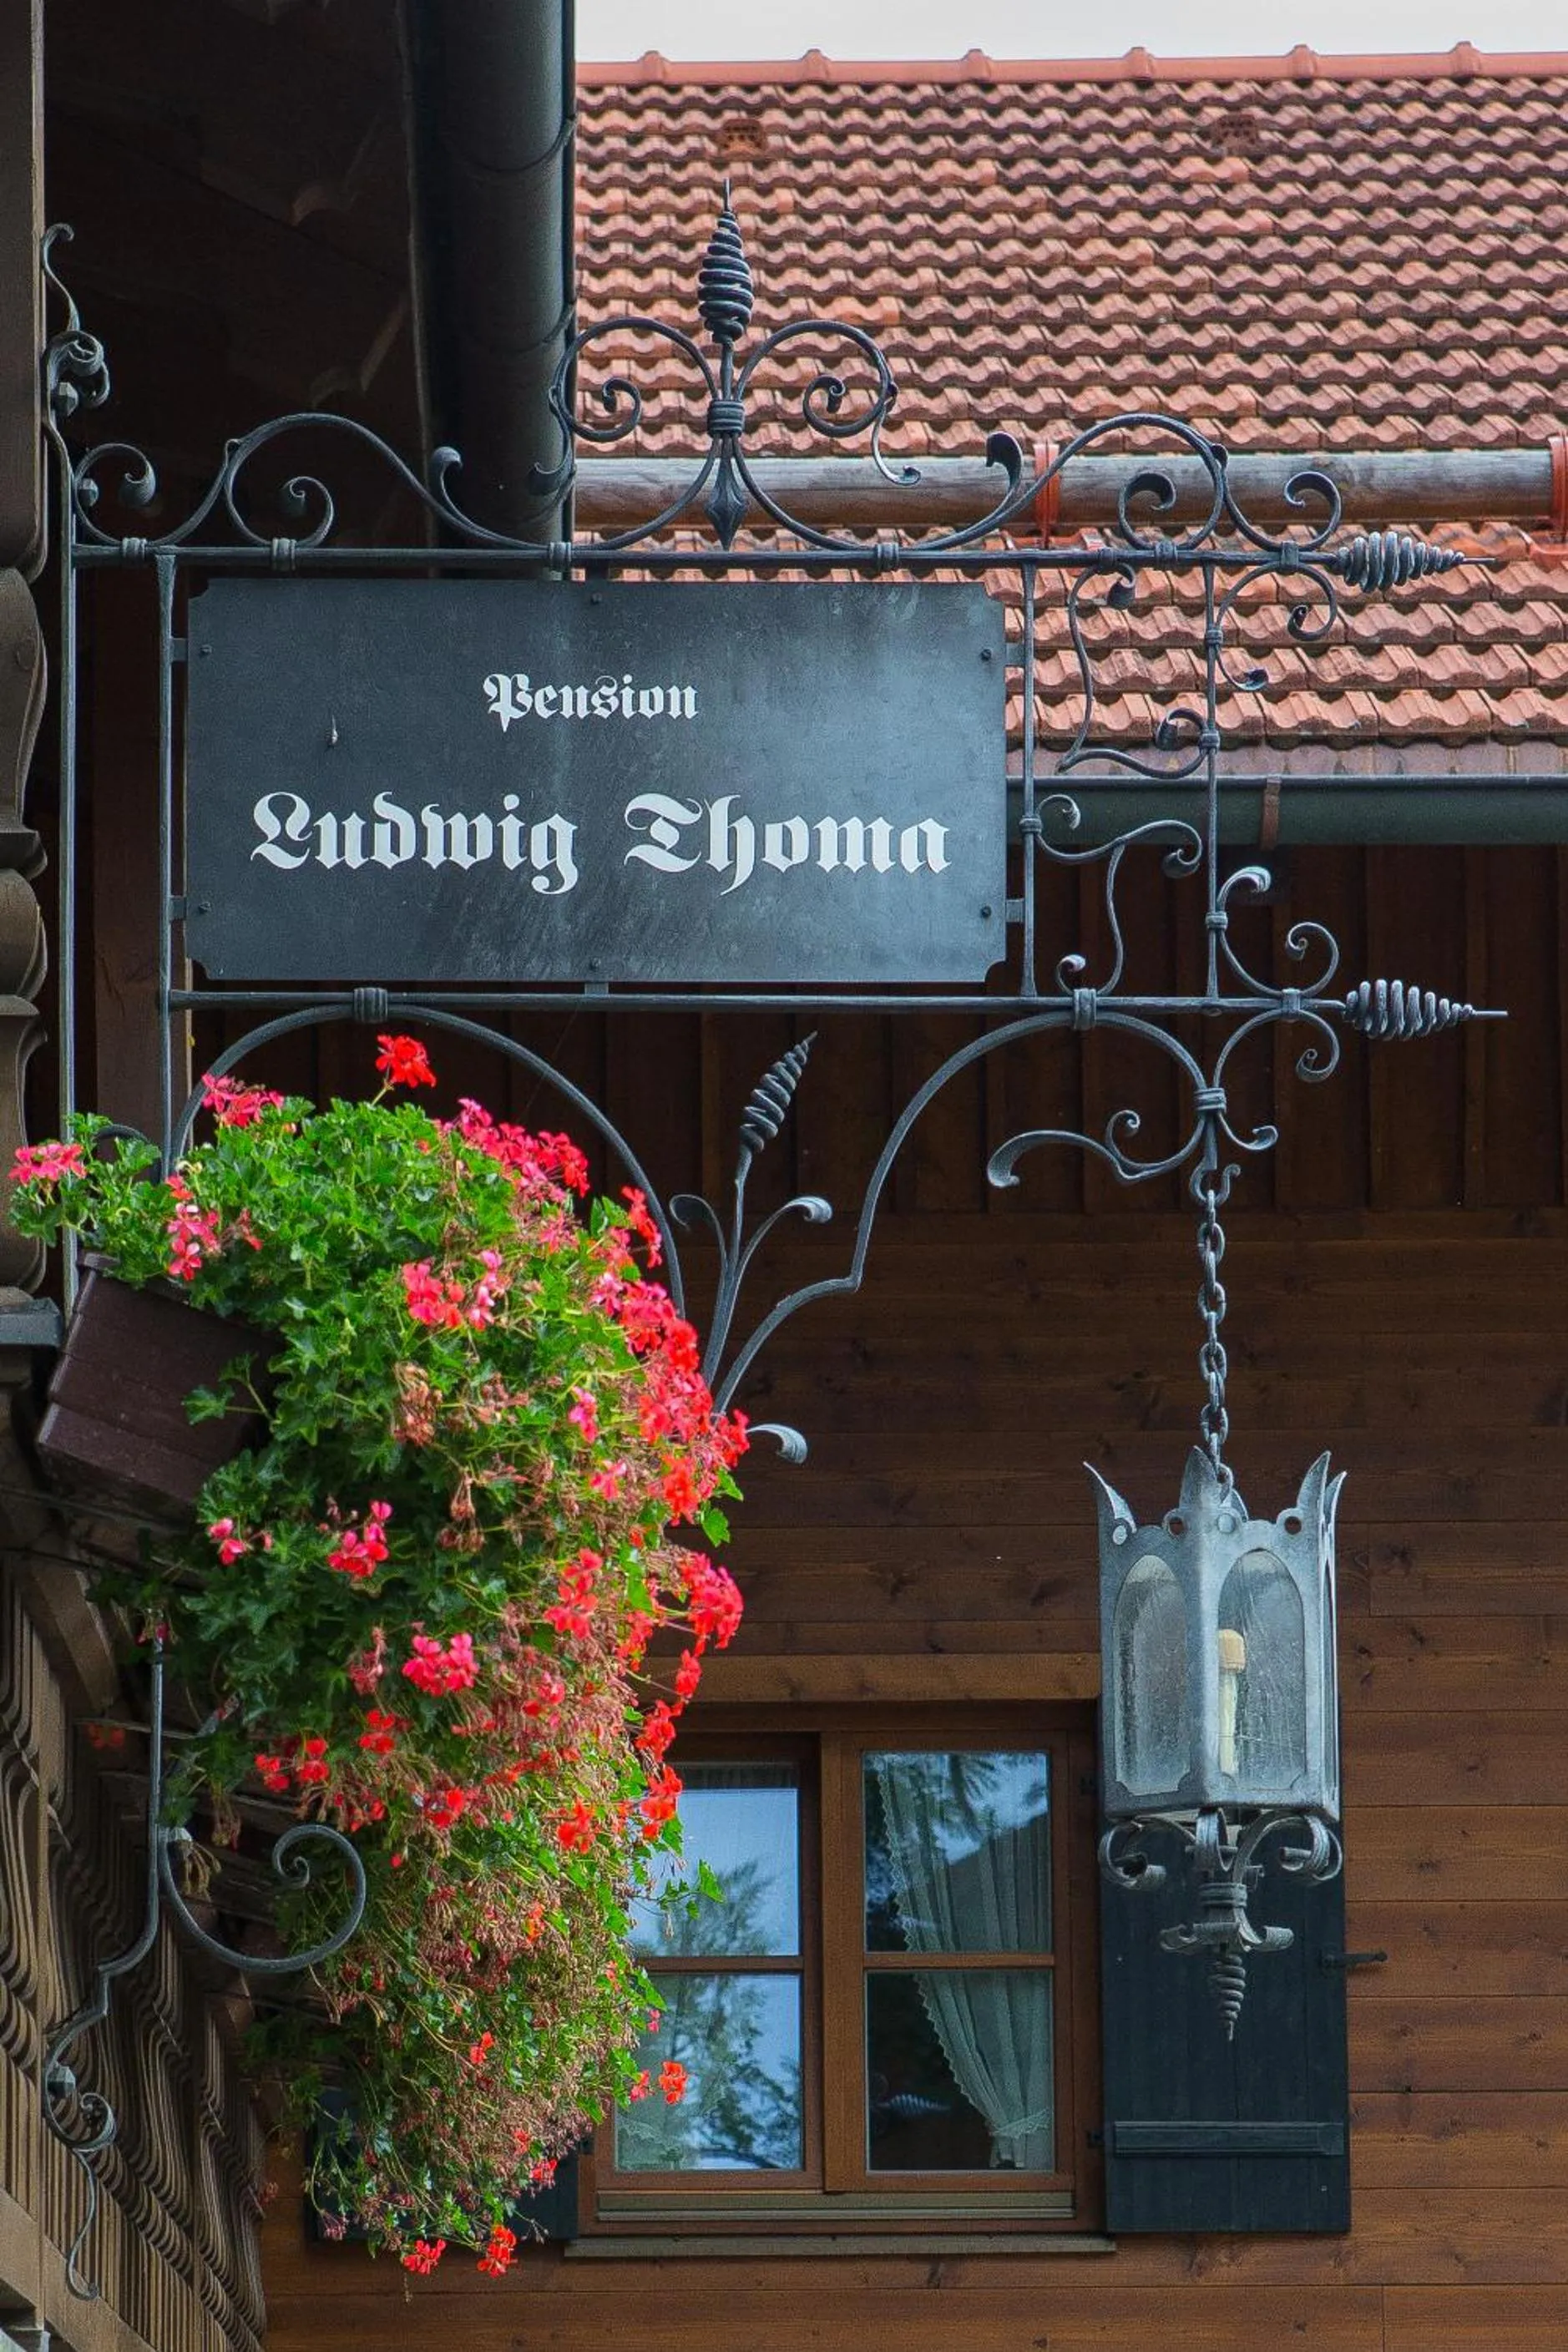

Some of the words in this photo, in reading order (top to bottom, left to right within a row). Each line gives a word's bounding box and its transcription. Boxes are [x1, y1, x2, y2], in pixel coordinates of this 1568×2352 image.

[483, 673, 699, 732] Pension
[251, 792, 579, 895] Ludwig
[624, 793, 952, 897] Thoma
